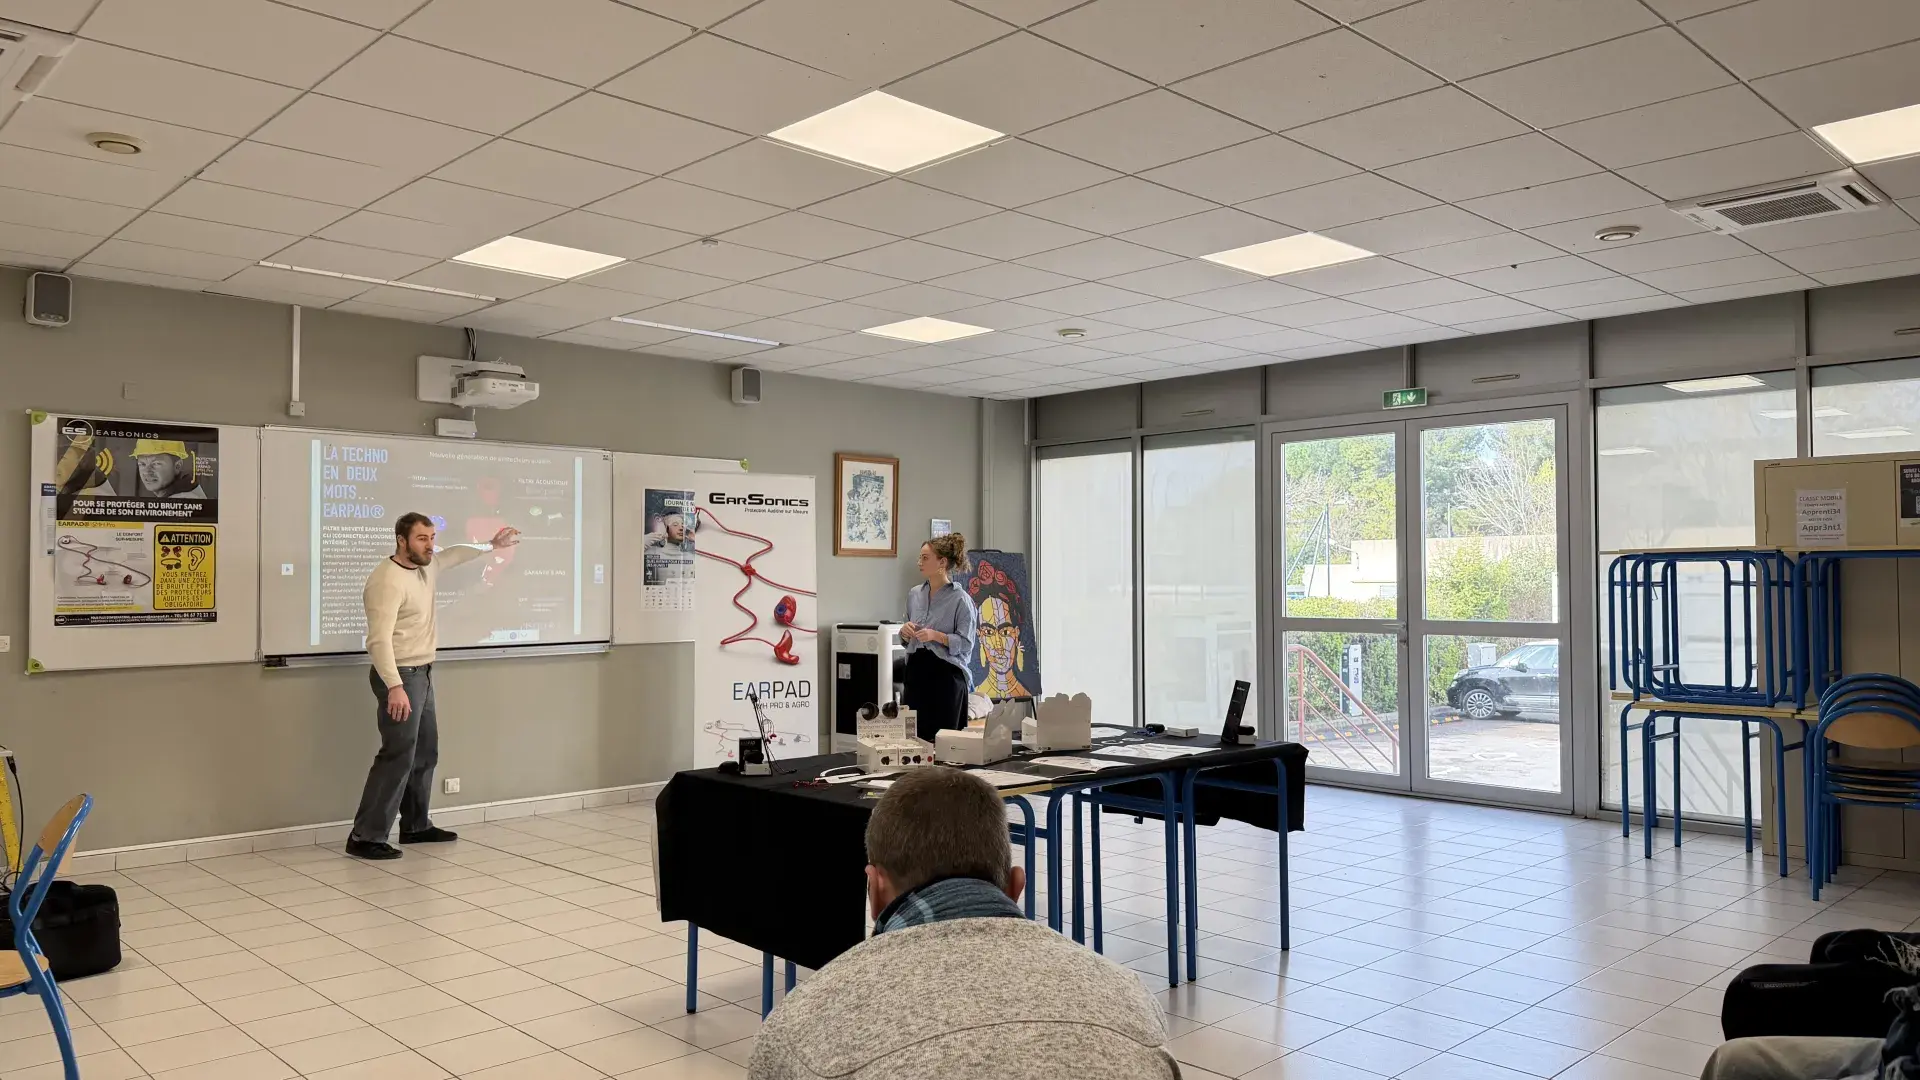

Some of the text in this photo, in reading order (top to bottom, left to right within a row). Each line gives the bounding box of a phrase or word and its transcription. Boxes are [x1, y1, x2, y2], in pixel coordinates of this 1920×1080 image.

[96, 430, 158, 438] EARSONICS
[324, 446, 388, 463] LA TECHNO
[324, 465, 378, 481] EN DEUX
[107, 500, 145, 508] PROTÉGER
[1802, 524, 1842, 532] Appr3nt1
[171, 534, 211, 543] ATTENTION
[733, 680, 811, 700] EARPAD
